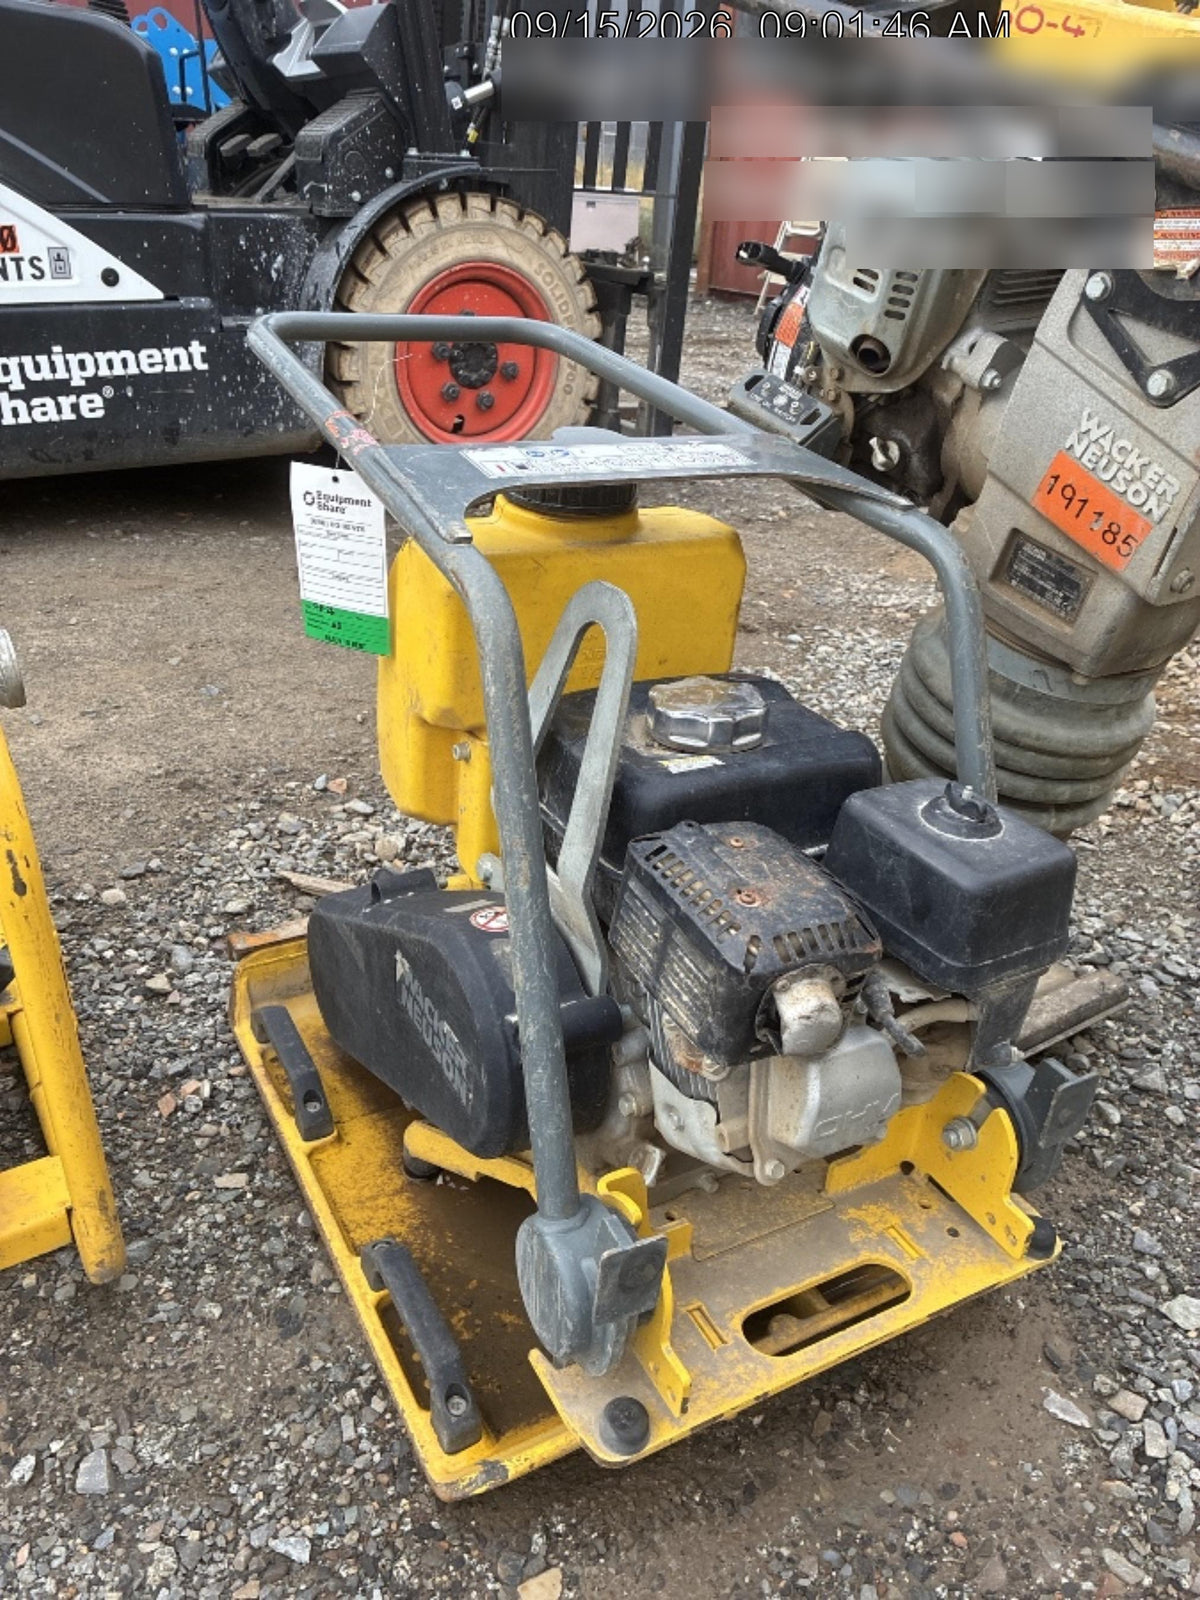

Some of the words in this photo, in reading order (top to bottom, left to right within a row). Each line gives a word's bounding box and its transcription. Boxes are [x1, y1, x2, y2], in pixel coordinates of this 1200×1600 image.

[316, 490, 372, 507] Equipment
[1065, 430, 1171, 525] NEUSON
[1080, 407, 1181, 504] WACKER
[1046, 473, 1139, 558] 191185
